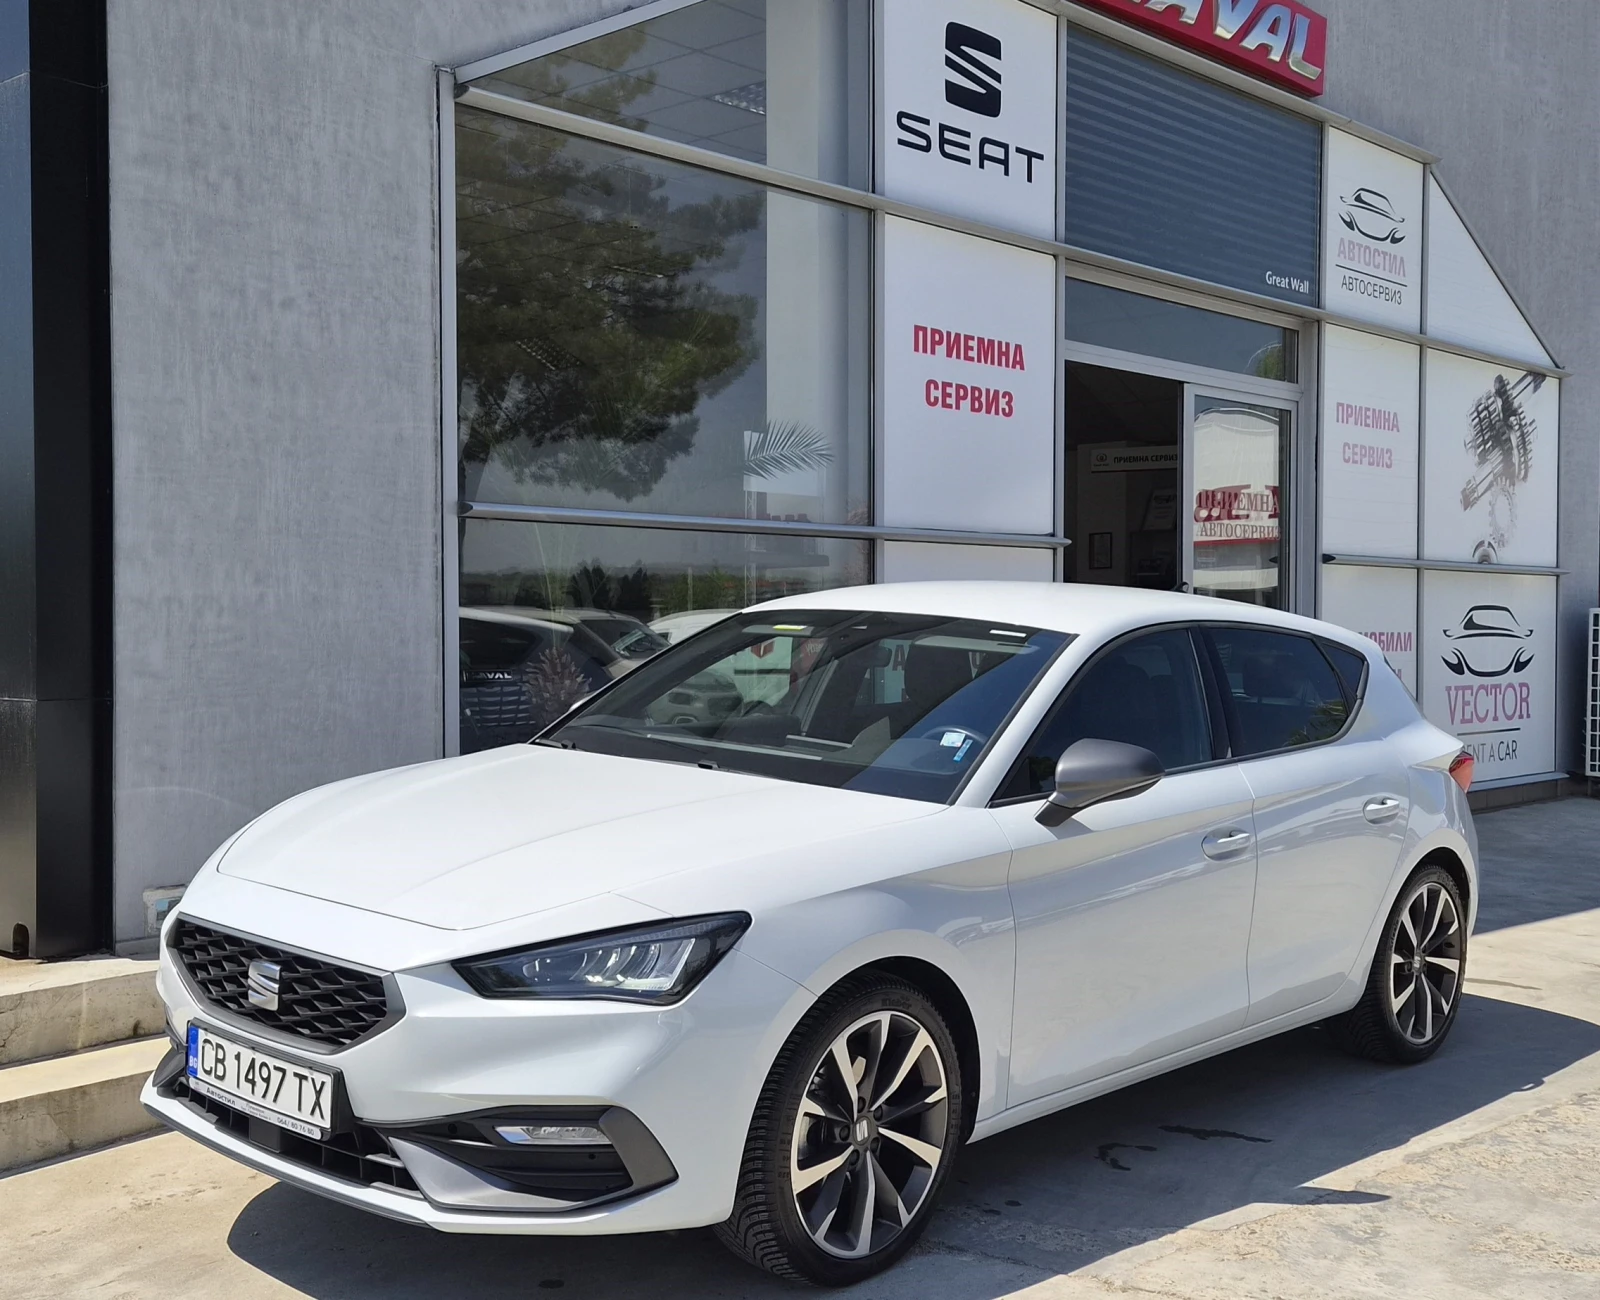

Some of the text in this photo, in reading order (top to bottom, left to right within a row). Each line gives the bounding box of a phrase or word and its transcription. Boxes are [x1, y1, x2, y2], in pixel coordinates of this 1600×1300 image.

[1135, 0, 1322, 80] VAL
[897, 111, 1044, 183] SEAT
[1337, 237, 1406, 277] АВТОСТИЛ
[1265, 271, 1309, 294] Great Wall
[1341, 275, 1402, 305] АВТОСЕРВИЗ
[914, 324, 1025, 371] ПРИЕМНА
[925, 379, 1014, 418] СЕРВИЗ
[1336, 402, 1400, 432] ПРИЕМНА
[1113, 455, 1149, 464] ПРИЕМНА
[1343, 442, 1392, 469] СЕРВИЗ
[1200, 522, 1281, 540] АВТОСЕРВИЗ
[1358, 632, 1412, 652] БИЛИ
[1445, 682, 1531, 725] VECTOR
[1488, 742, 1495, 762] A
[1497, 740, 1518, 761] CAR
[189, 1056, 198, 1068] BG
[234, 1051, 287, 1103] 1497
